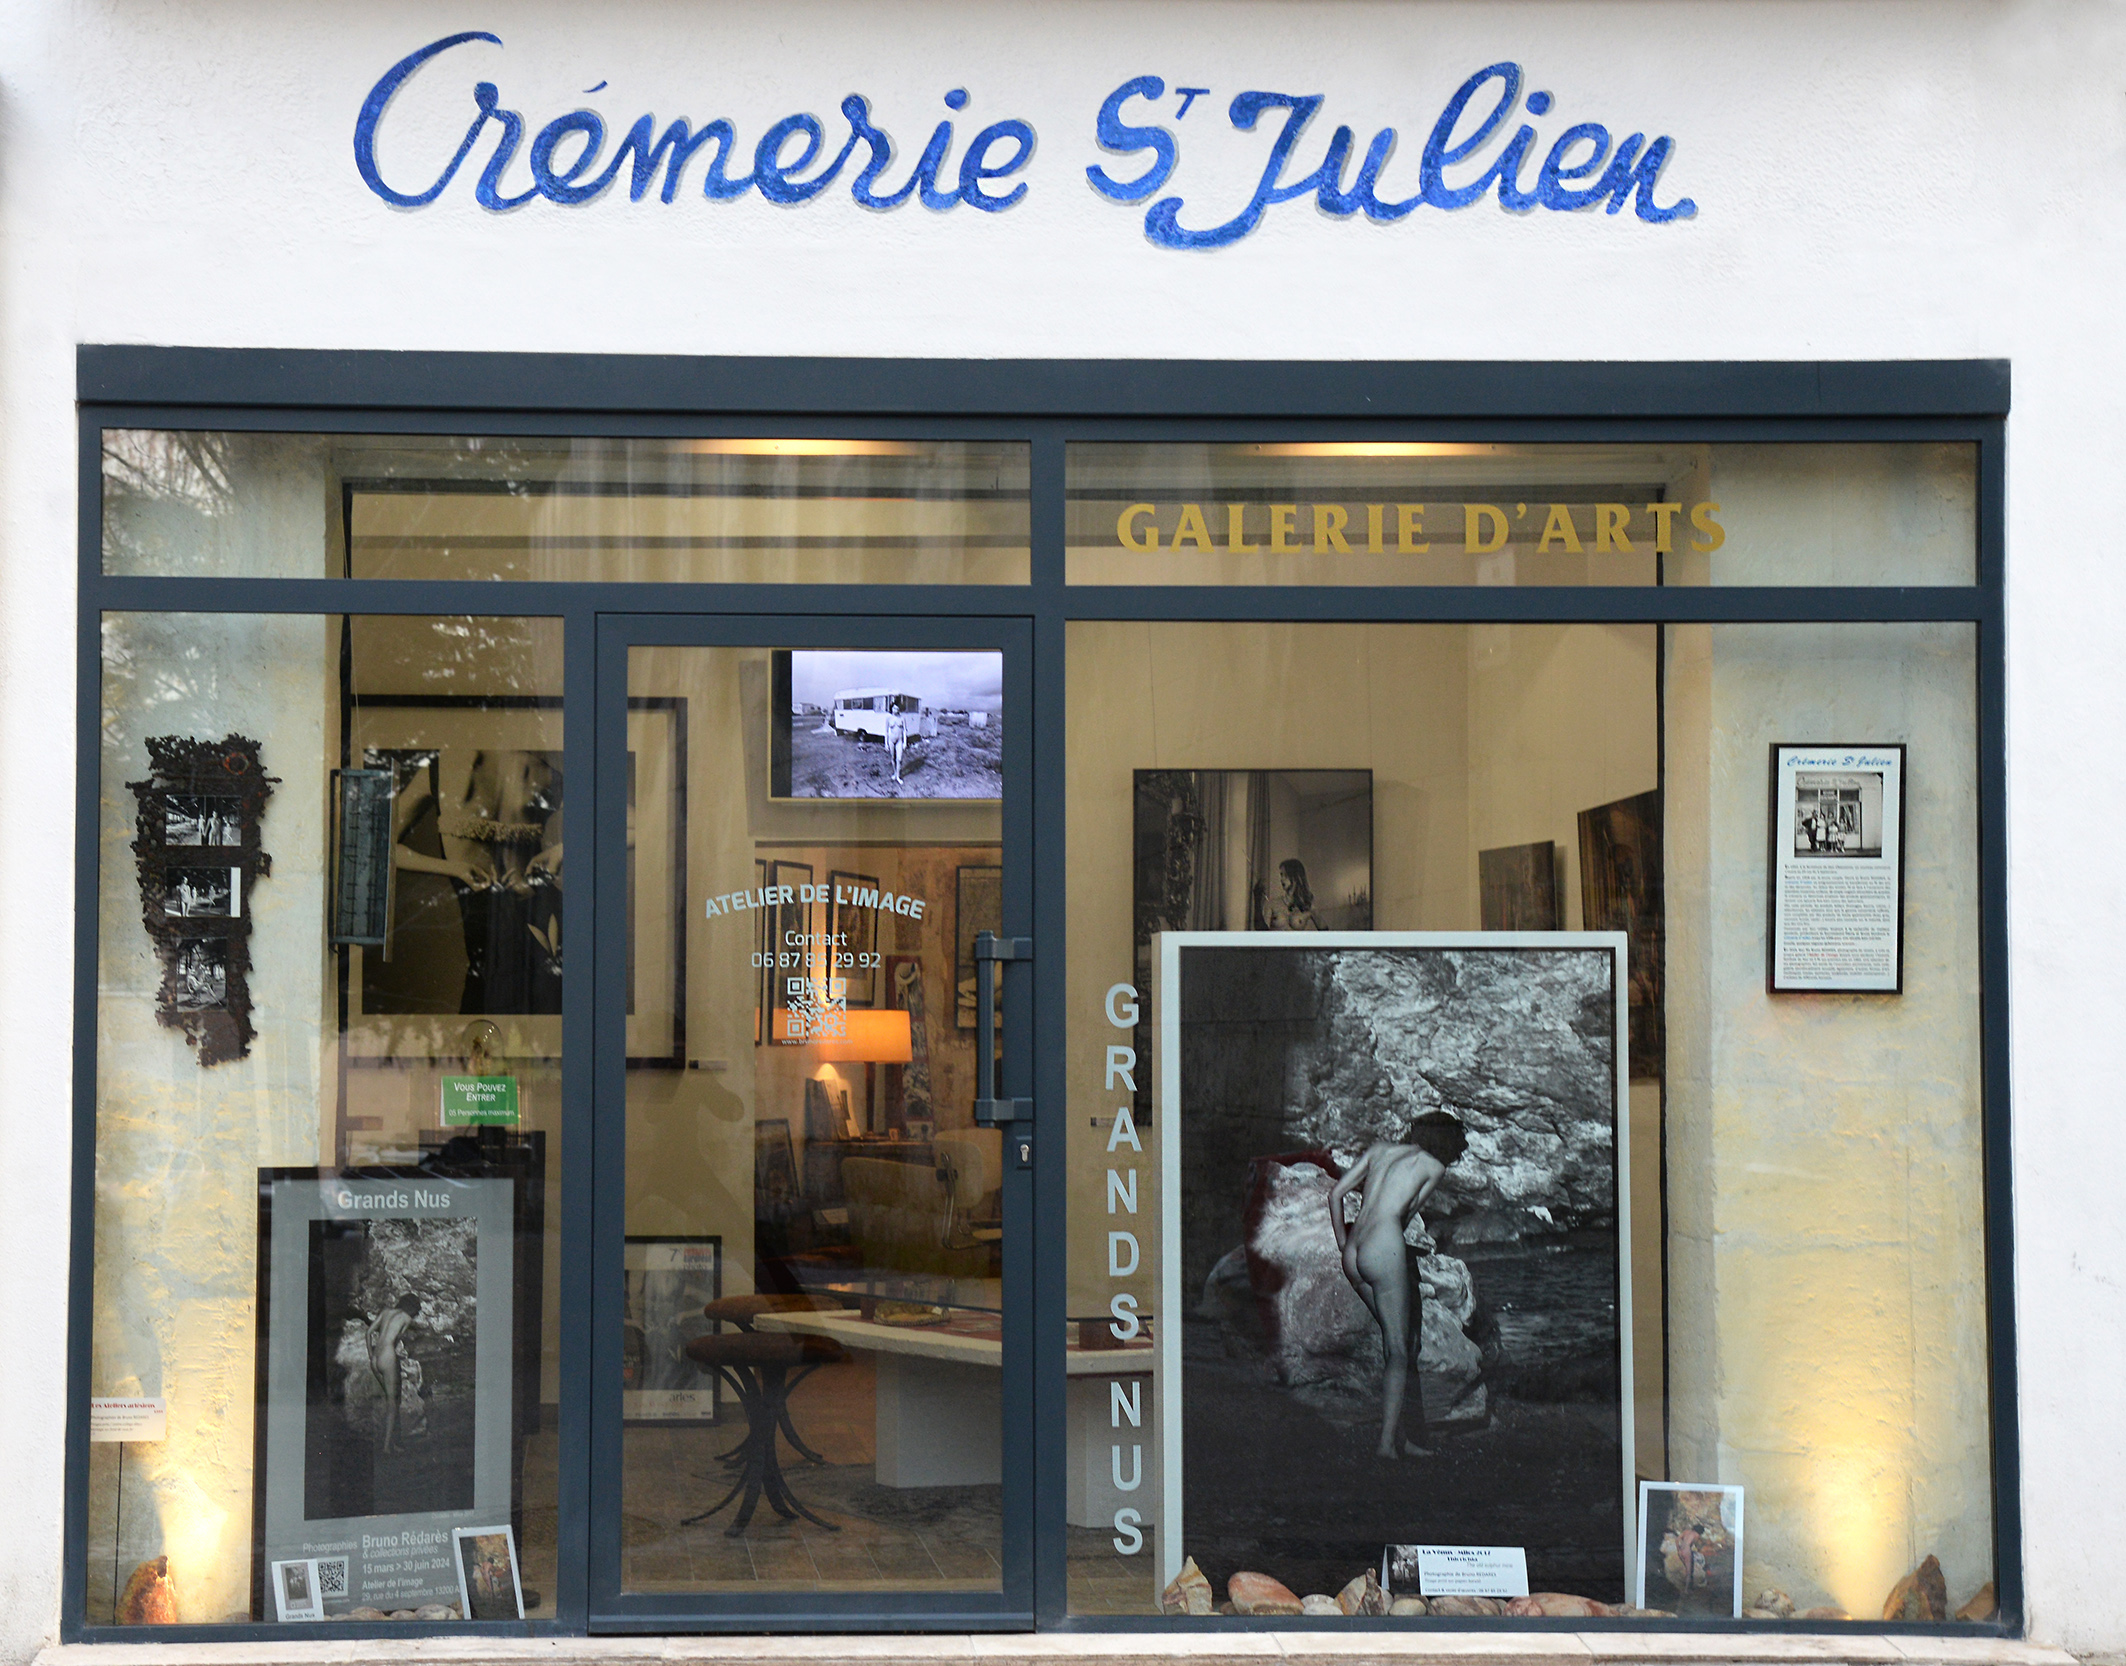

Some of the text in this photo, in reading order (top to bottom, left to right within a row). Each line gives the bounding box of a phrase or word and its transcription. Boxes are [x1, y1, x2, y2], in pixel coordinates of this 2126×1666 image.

[354, 31, 1036, 212] Crémerie
[1144, 61, 1698, 251] Julien
[1116, 501, 1726, 554] GALERIE D'ARTS
[705, 883, 926, 920] ATELIER DE L'IMAGE
[785, 930, 848, 947] Contact
[752, 952, 774, 969] 06
[779, 952, 801, 968] 87
[833, 952, 854, 968] 29
[859, 952, 881, 969] 92
[1104, 982, 1143, 1341] GRANDS
[337, 1189, 451, 1210] Grands Nus
[1109, 1381, 1144, 1556] NUS
[362, 1529, 449, 1549] Bruno Rédarès
[370, 1546, 410, 1558] collections
[363, 1563, 373, 1574] 15
[374, 1563, 395, 1573] mars
[403, 1560, 413, 1571] 30
[414, 1560, 430, 1573] juin
[431, 1557, 450, 1569] 2024
[362, 1579, 385, 1590] Atelier
[387, 1578, 396, 1588] de
